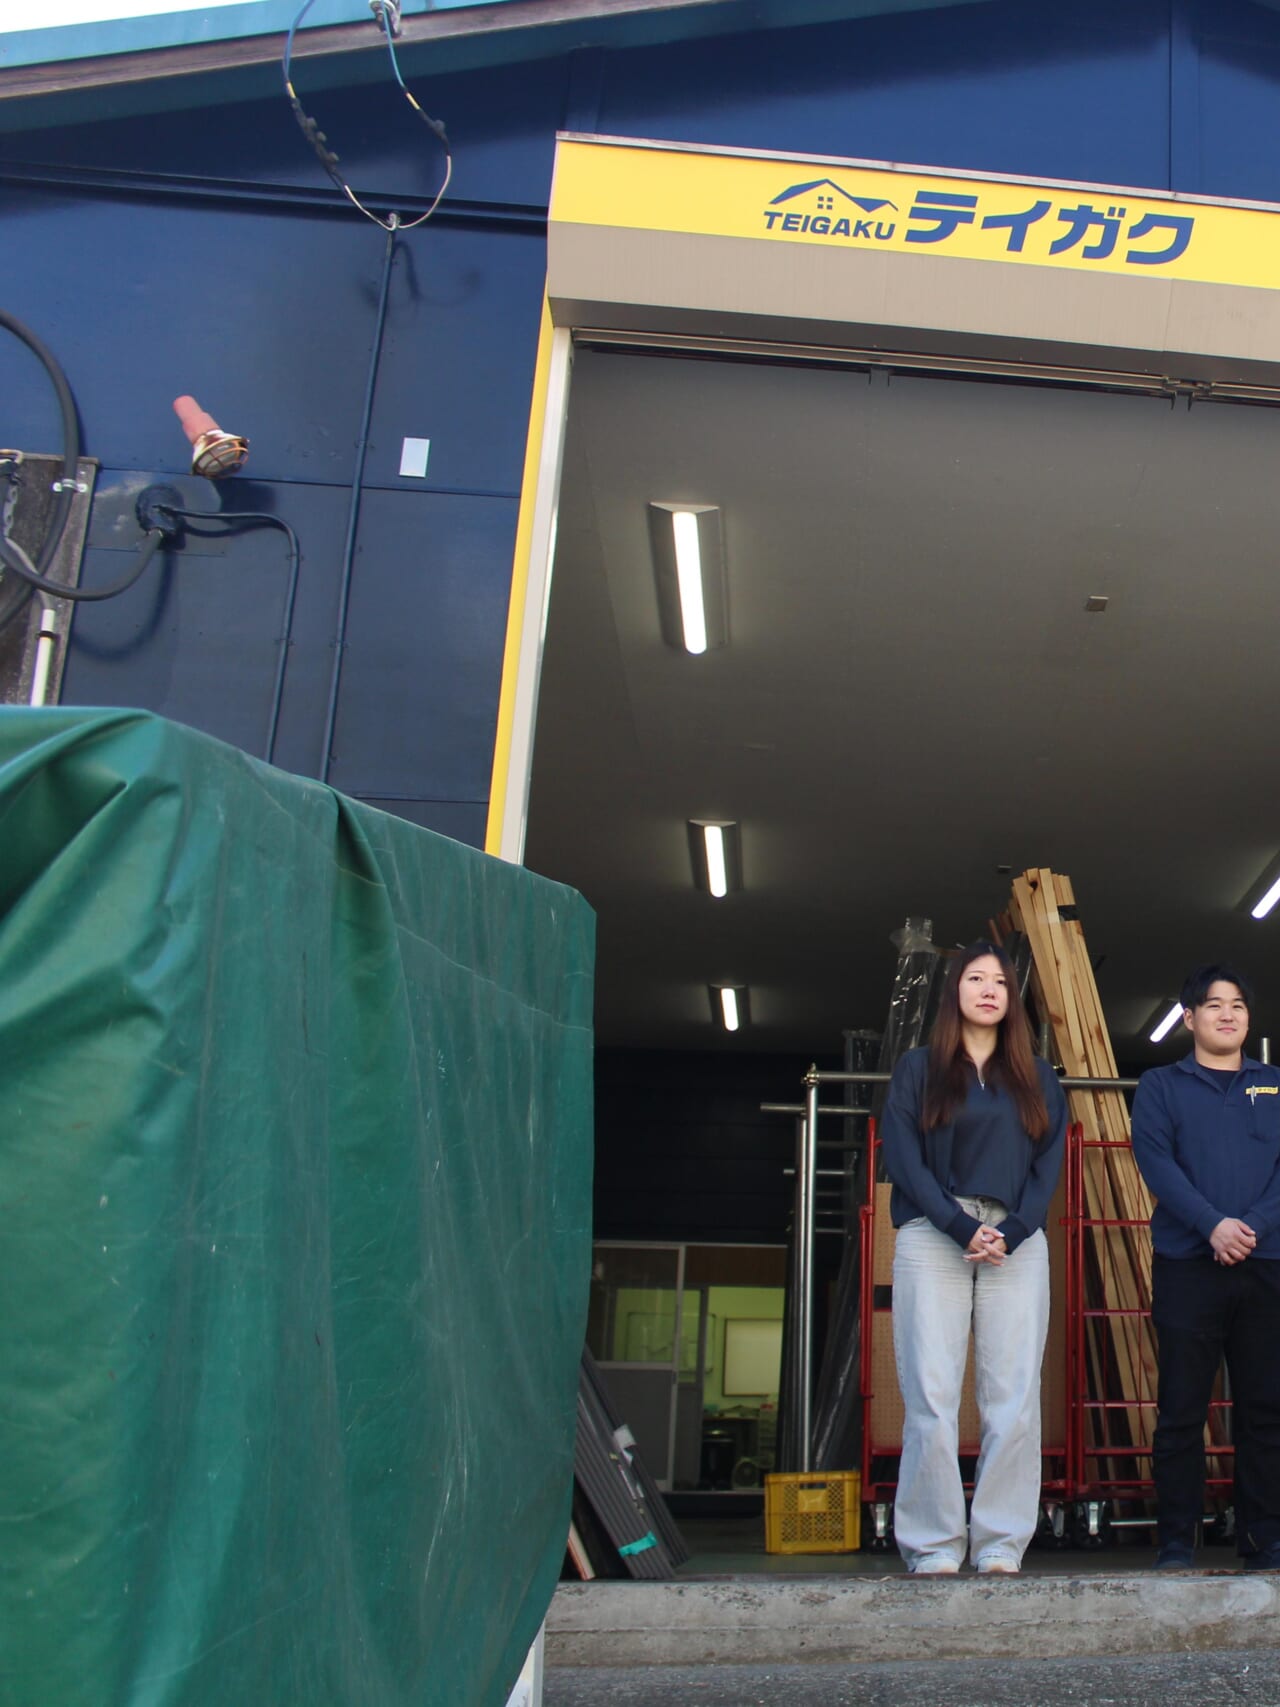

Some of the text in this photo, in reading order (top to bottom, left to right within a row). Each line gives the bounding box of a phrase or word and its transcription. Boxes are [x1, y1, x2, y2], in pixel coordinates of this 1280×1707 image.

[763, 189, 1196, 266] TEIGAKU テイガク
